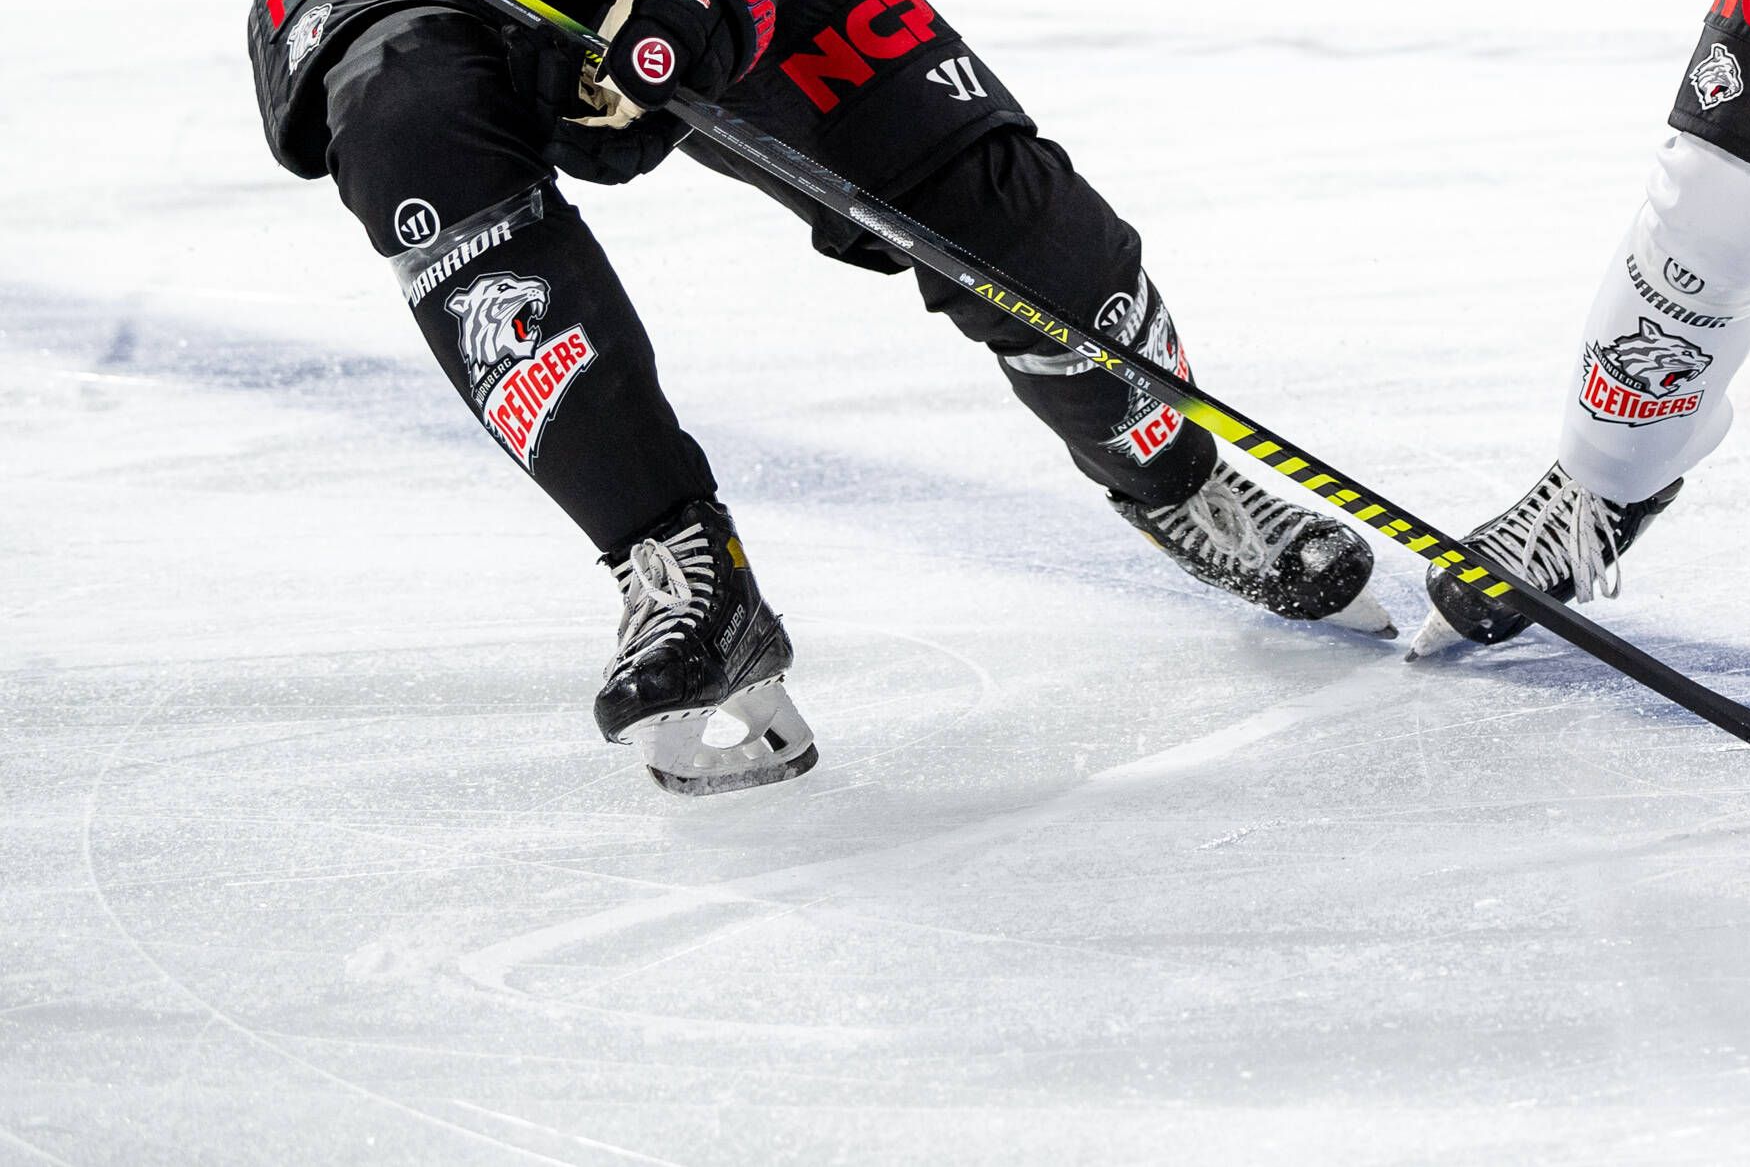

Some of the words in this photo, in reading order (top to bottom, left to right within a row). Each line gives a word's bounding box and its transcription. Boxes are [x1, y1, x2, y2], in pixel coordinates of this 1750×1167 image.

[975, 284, 1069, 343] ALPHA
[488, 333, 587, 459] ICETIGERS
[1584, 363, 1699, 419] ICETIGERS
